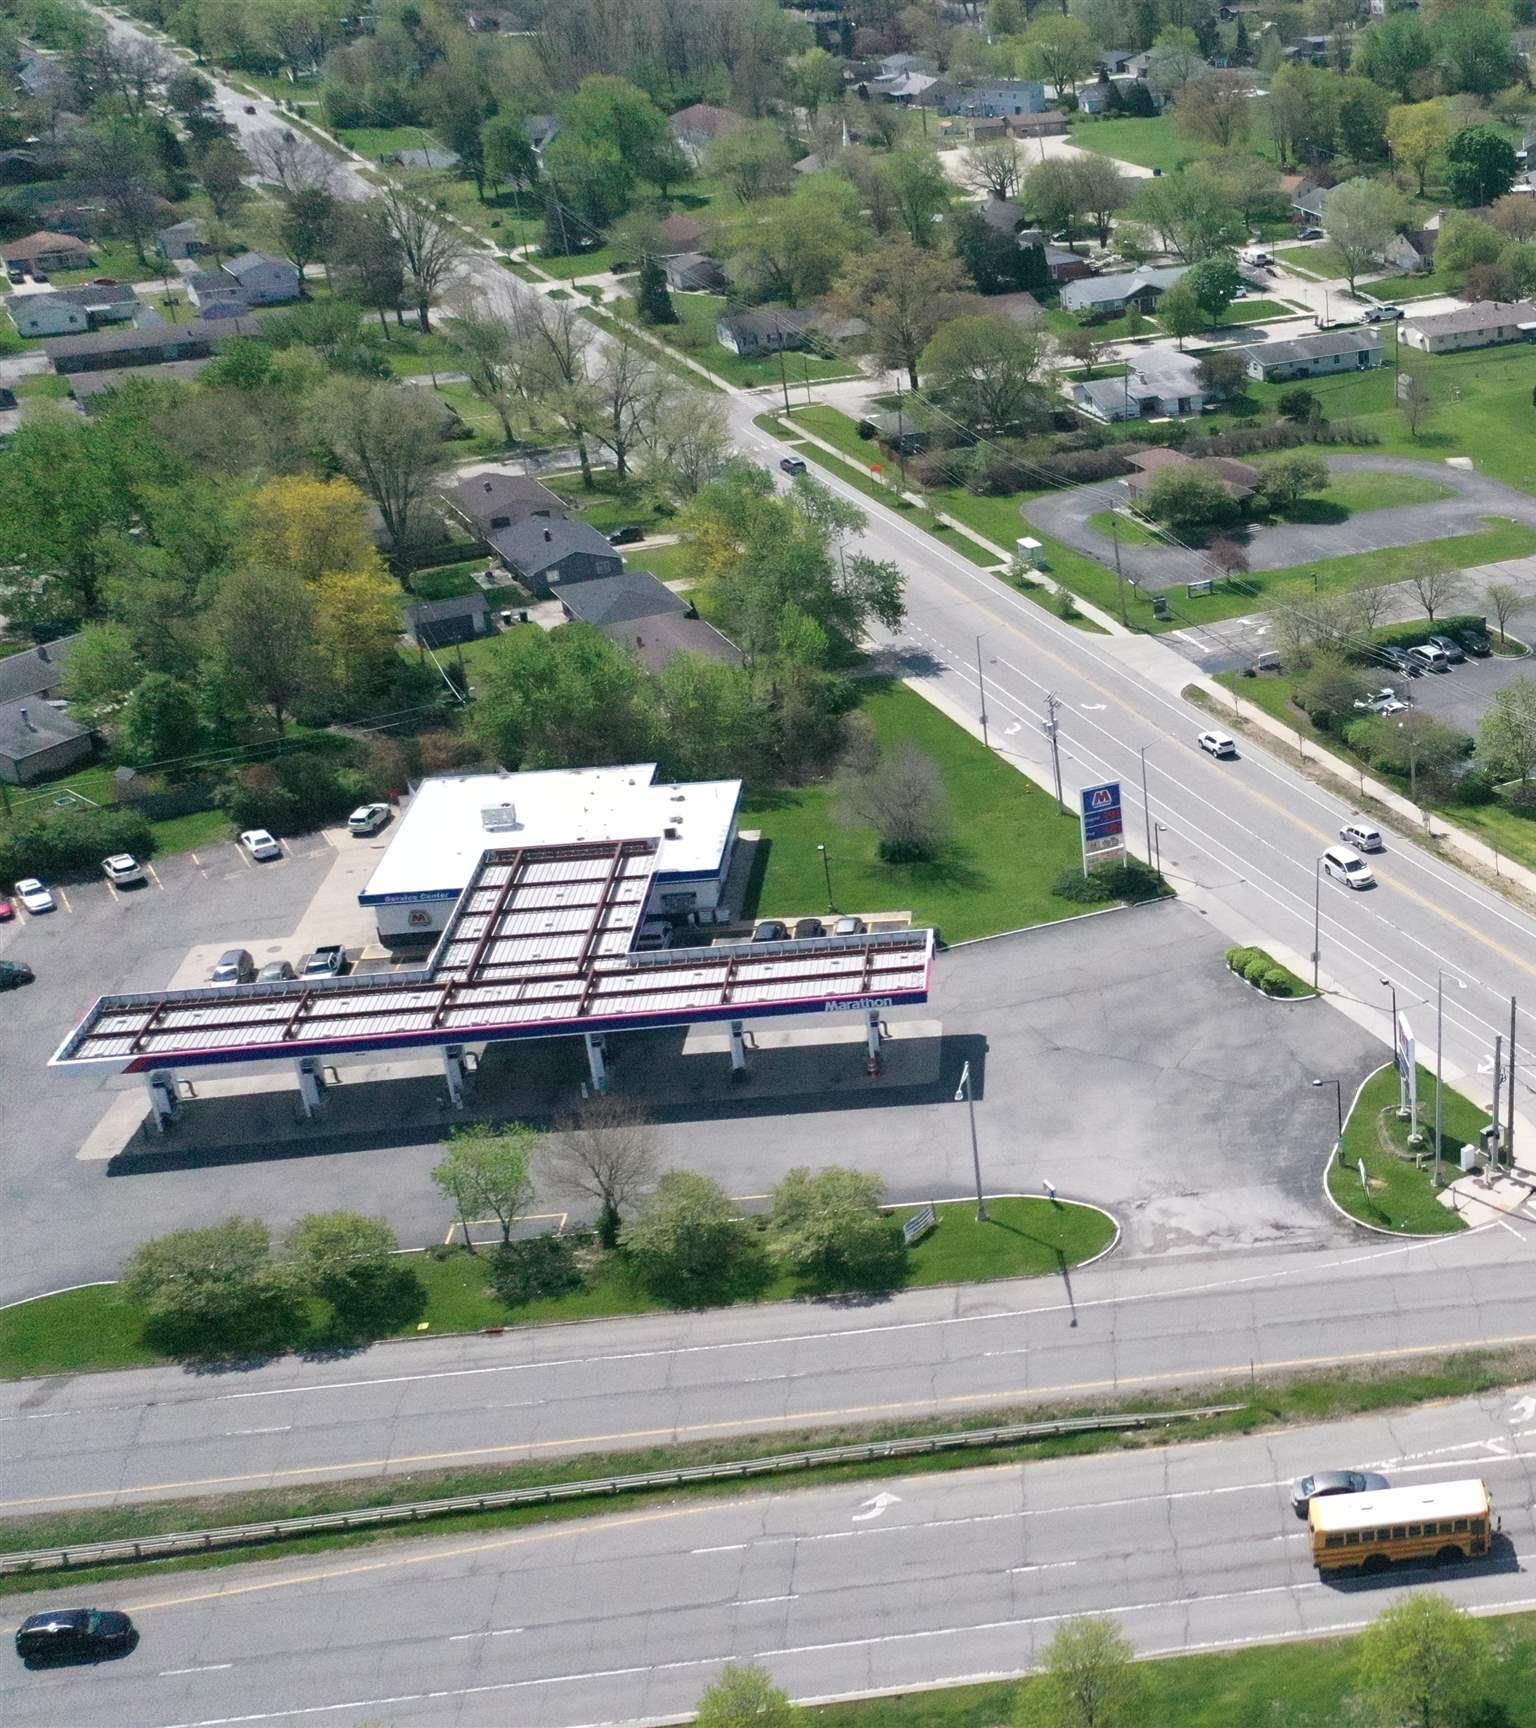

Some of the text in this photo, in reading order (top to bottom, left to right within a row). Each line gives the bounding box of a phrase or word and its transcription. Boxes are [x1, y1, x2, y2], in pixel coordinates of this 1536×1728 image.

[384, 893, 449, 903] Service Center
[824, 997, 892, 1012] Marathon
